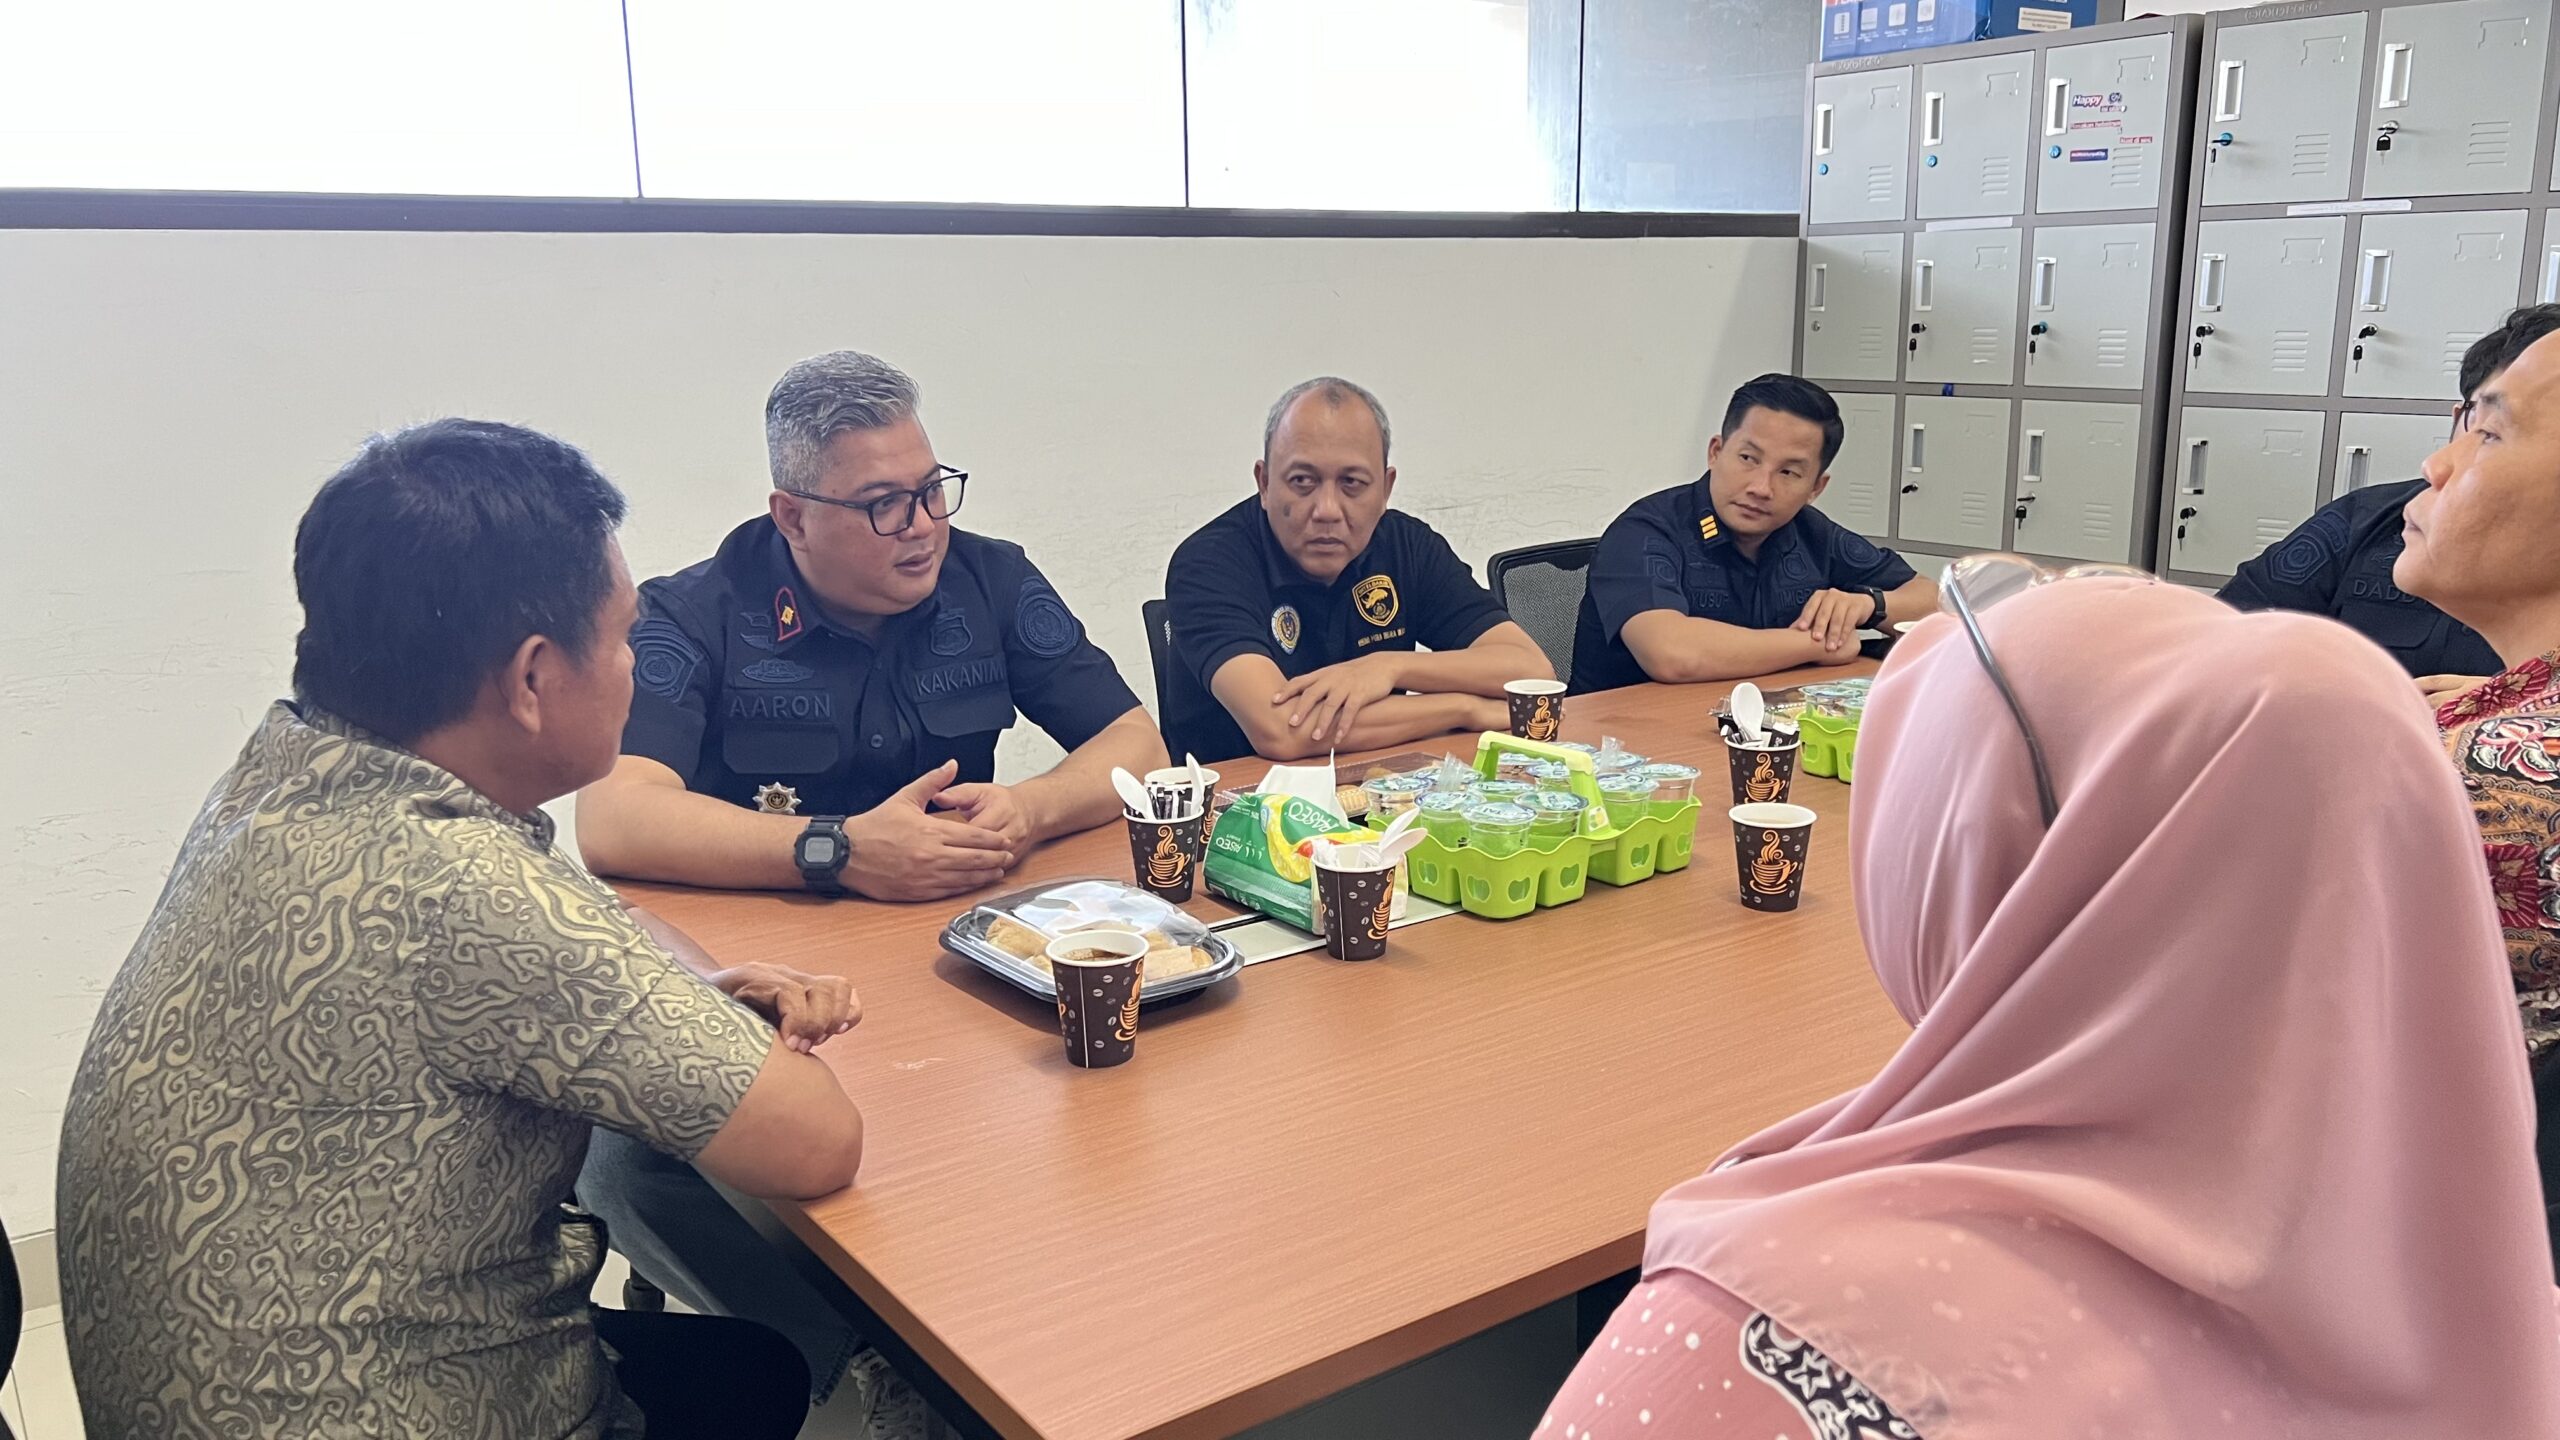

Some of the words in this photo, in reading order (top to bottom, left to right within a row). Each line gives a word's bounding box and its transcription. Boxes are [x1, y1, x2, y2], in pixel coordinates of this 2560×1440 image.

[2073, 95, 2102, 107] Happy
[729, 693, 831, 718] AARON
[1288, 801, 1339, 833] PASEO
